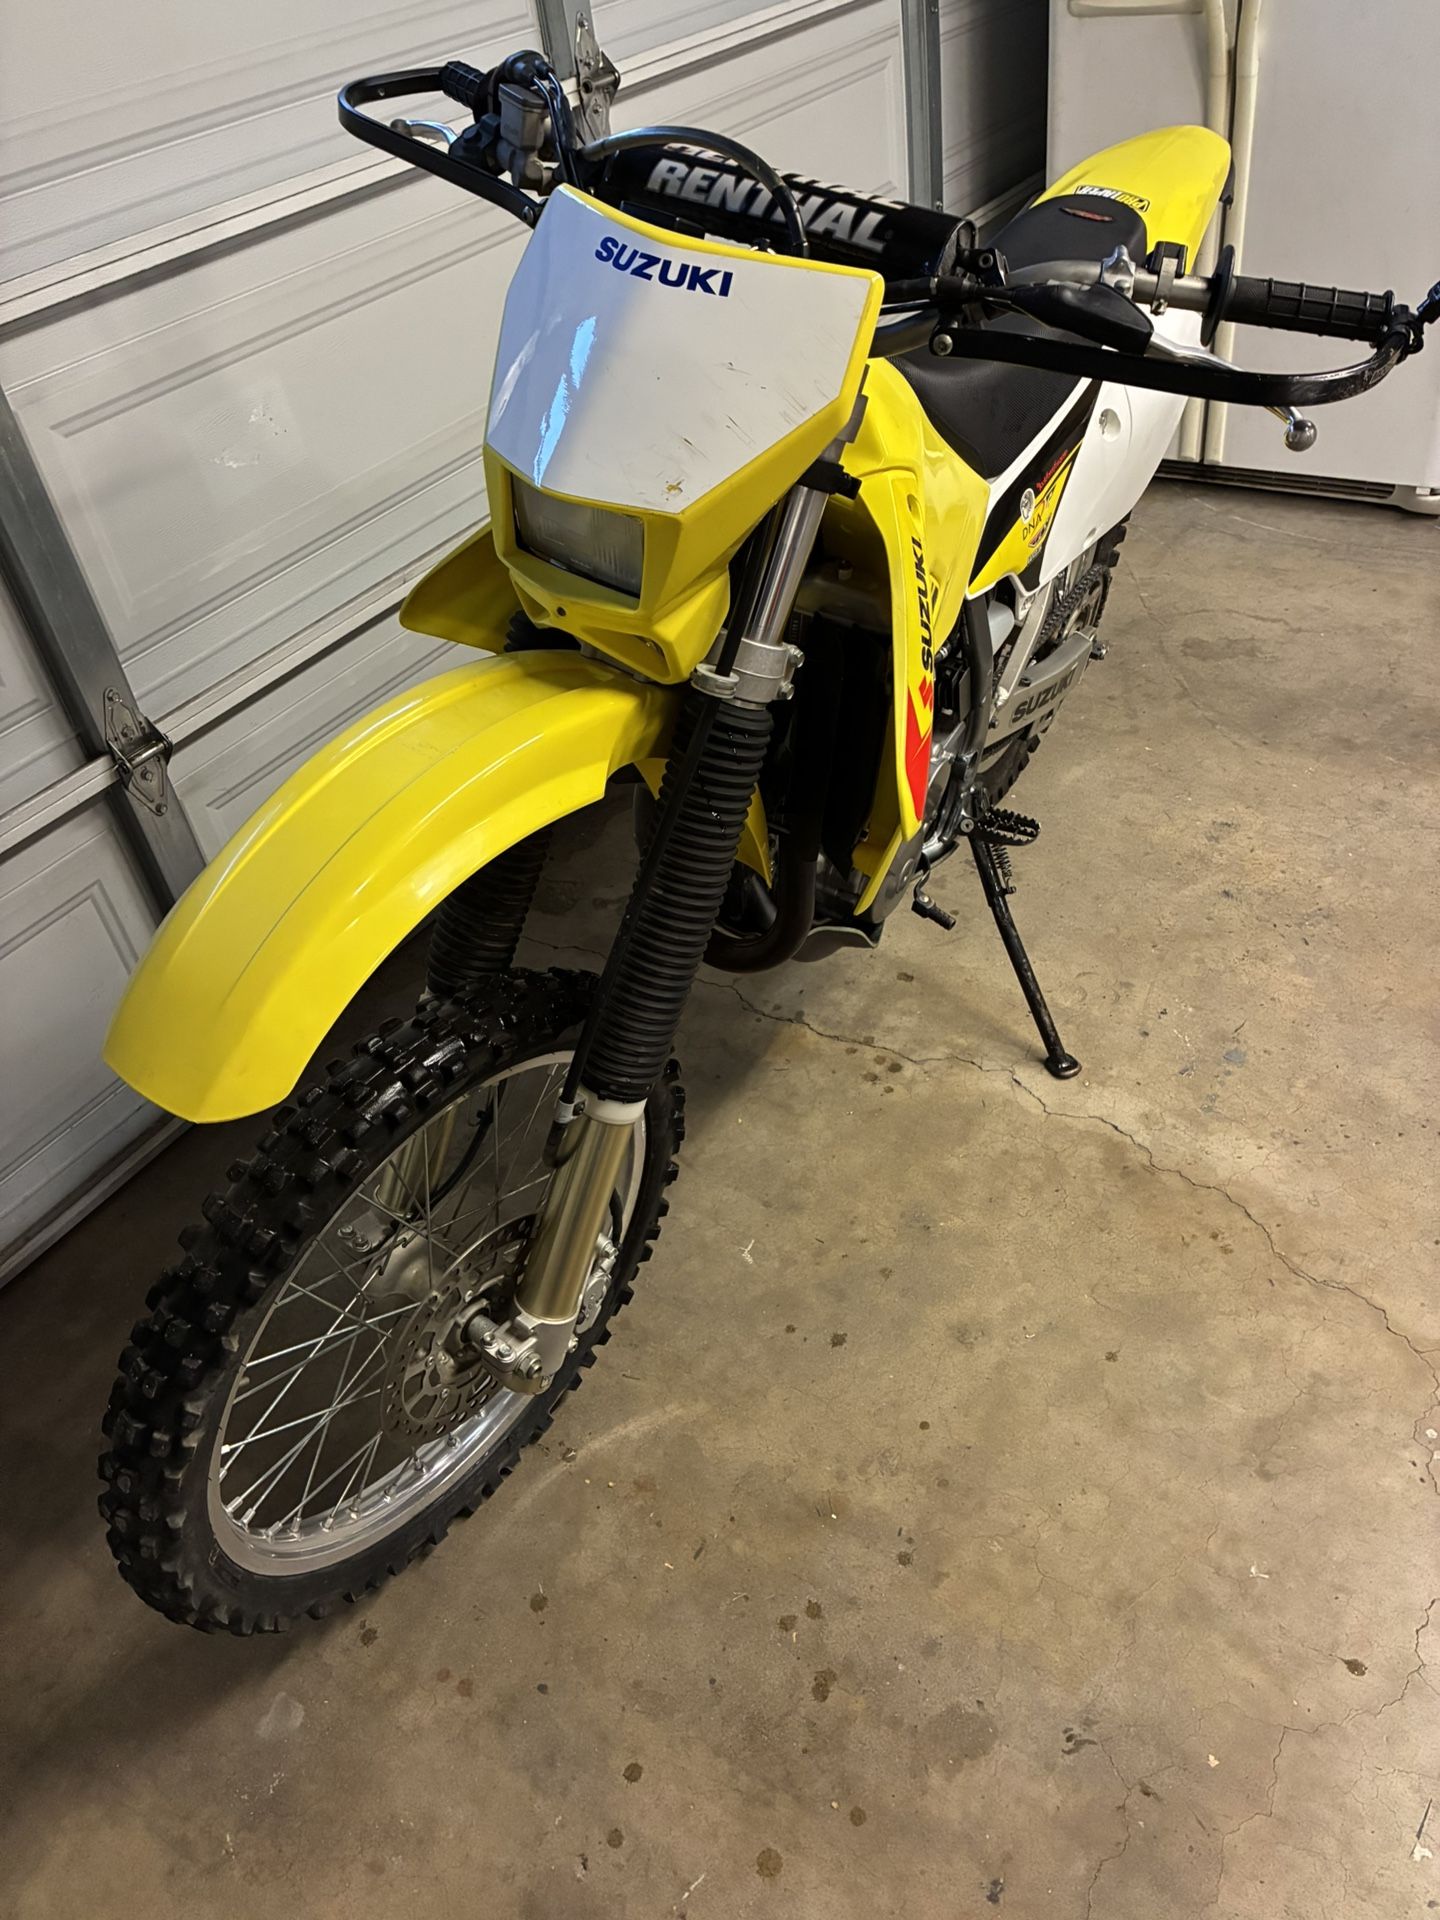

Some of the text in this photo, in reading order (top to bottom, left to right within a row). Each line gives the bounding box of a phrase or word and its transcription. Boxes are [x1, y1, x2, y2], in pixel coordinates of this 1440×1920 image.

[647, 158, 888, 254] RENTHAL
[595, 236, 734, 298] SUZUKI
[911, 535, 933, 674] SUZUKI
